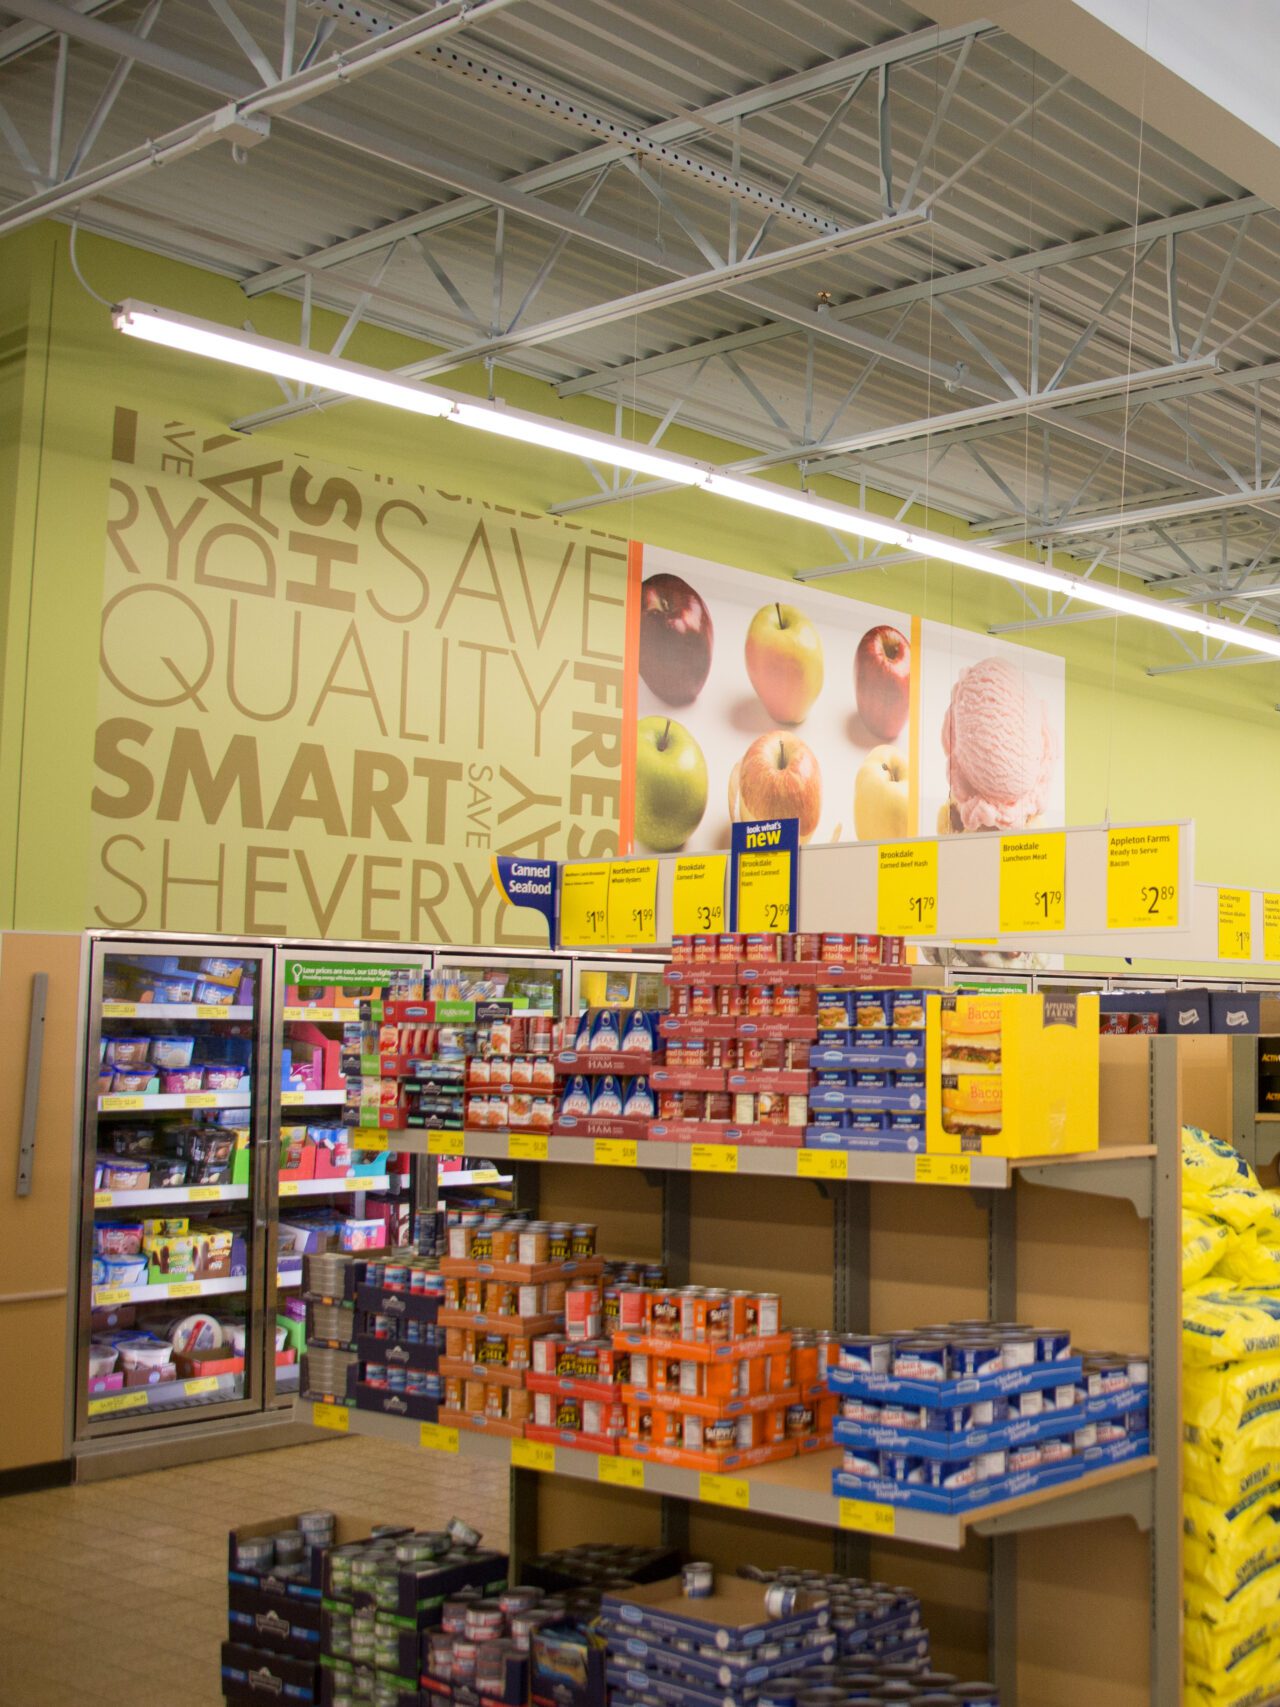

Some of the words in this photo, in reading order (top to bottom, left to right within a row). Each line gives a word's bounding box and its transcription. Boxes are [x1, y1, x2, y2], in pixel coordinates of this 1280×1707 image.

[366, 498, 630, 664] SAVE
[99, 582, 570, 758] QUALITY
[566, 661, 627, 860] FRES
[91, 716, 463, 846] SMART
[464, 762, 494, 850] SAVE
[746, 825, 760, 834] look
[761, 822, 781, 832] what's
[746, 830, 781, 849] new
[1110, 835, 1146, 847] Appleton
[1147, 834, 1170, 844] Farms
[1003, 841, 1040, 852] Brookdale
[880, 850, 914, 859] Brookdale
[1110, 848, 1130, 857] Ready
[1131, 847, 1138, 855] to
[1139, 847, 1158, 855] Serve
[742, 858, 772, 867] Brookdale
[1003, 854, 1032, 863] Luncheon
[1032, 853, 1048, 861] Meat
[677, 863, 706, 872] Brookdale
[880, 862, 900, 870] Corned
[900, 860, 914, 868] Beef
[1110, 860, 1130, 868] Bacon
[511, 862, 551, 879] Canned
[612, 867, 636, 875] Northern
[636, 866, 651, 874] Catch
[509, 880, 551, 895] Seafood
[316, 967, 333, 976] prices
[1045, 1002, 1076, 1010] APPLETON
[1046, 1009, 1074, 1018] FARMS
[588, 1061, 613, 1069] HAM
[587, 1125, 612, 1134] HAM
